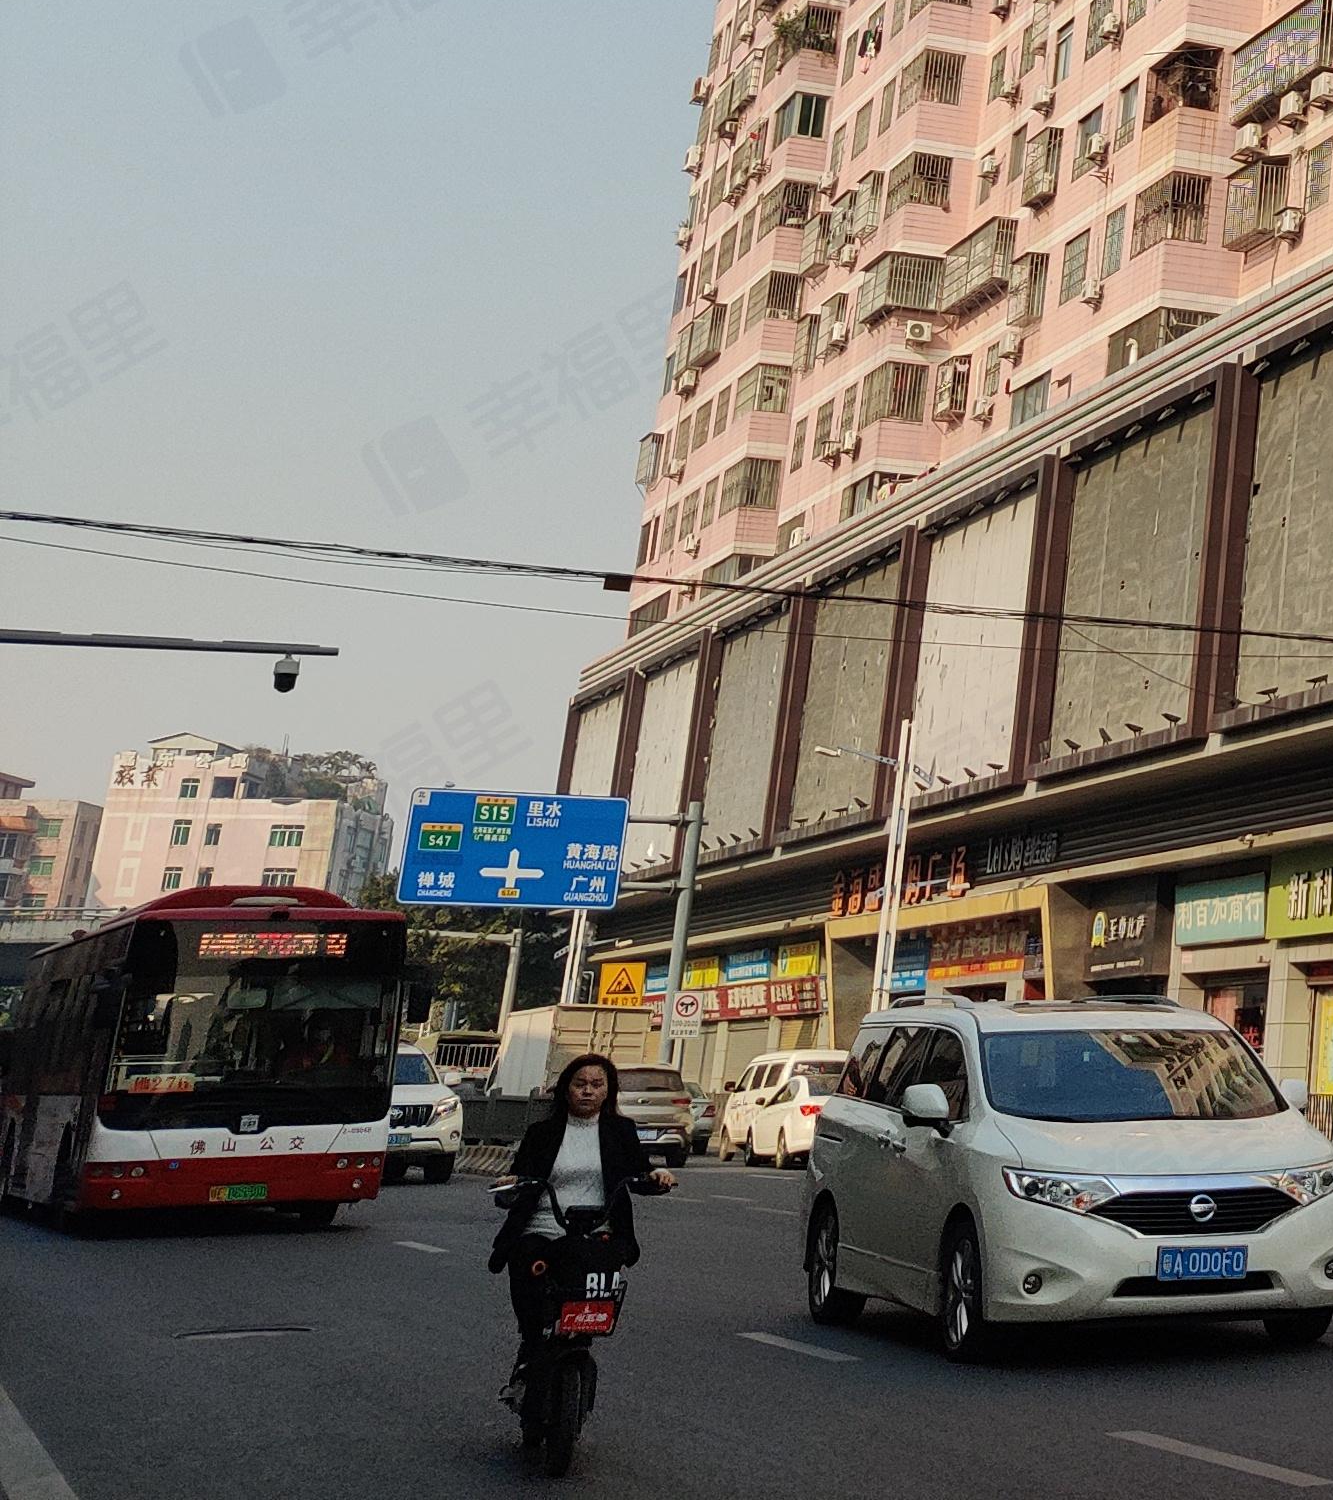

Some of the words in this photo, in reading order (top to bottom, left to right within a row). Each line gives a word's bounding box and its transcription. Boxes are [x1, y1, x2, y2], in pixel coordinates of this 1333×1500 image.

[479, 804, 510, 821] S15
[526, 800, 562, 818] 里水
[526, 817, 560, 828] LISHUI
[428, 833, 452, 847] S47
[566, 843, 618, 860] 黄海路
[563, 859, 606, 870] HUANGHAI
[606, 861, 617, 871] LU
[417, 871, 455, 889] 禅城
[570, 875, 606, 892] 广州
[831, 845, 968, 918] 金海盛码广场
[563, 891, 608, 903] GUANGZHOU
[1178, 892, 1263, 931] 利百加商行
[1108, 913, 1146, 942] 至尊比萨
[189, 1135, 306, 1156] 佛山公交
